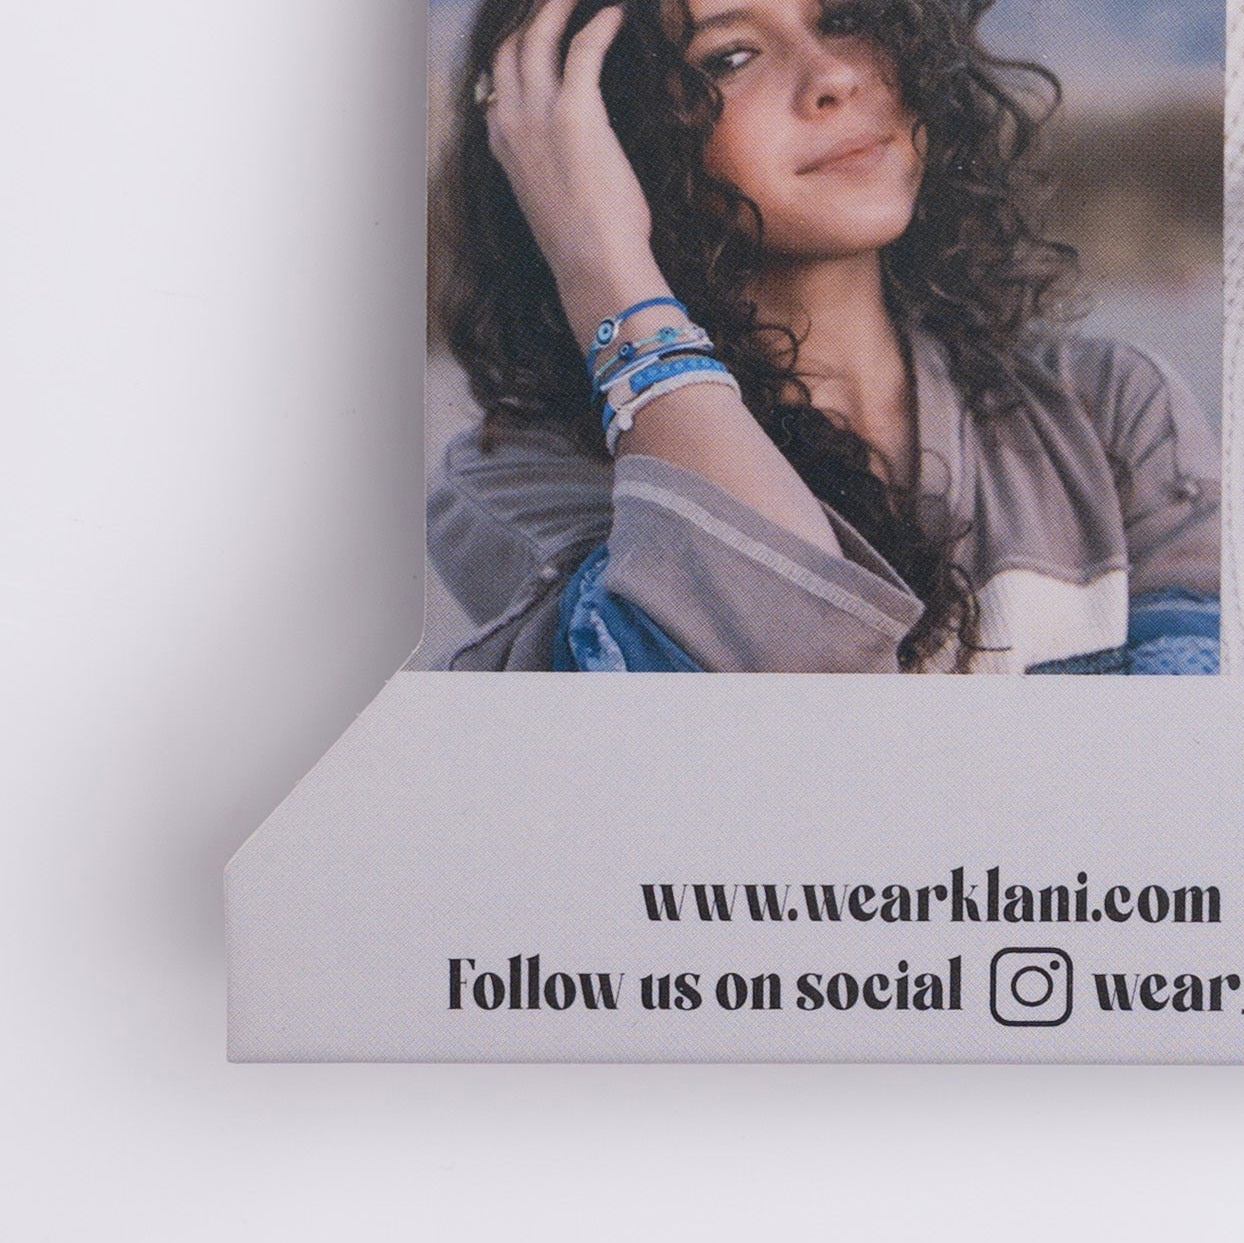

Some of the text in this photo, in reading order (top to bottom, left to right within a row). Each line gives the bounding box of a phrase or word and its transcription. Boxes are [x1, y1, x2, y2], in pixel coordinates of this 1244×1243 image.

[640, 865, 1222, 924] www.wearklani.com
[447, 953, 625, 1012] Follow
[639, 971, 703, 1012] us
[715, 971, 783, 1011] on
[796, 954, 963, 1012] social
